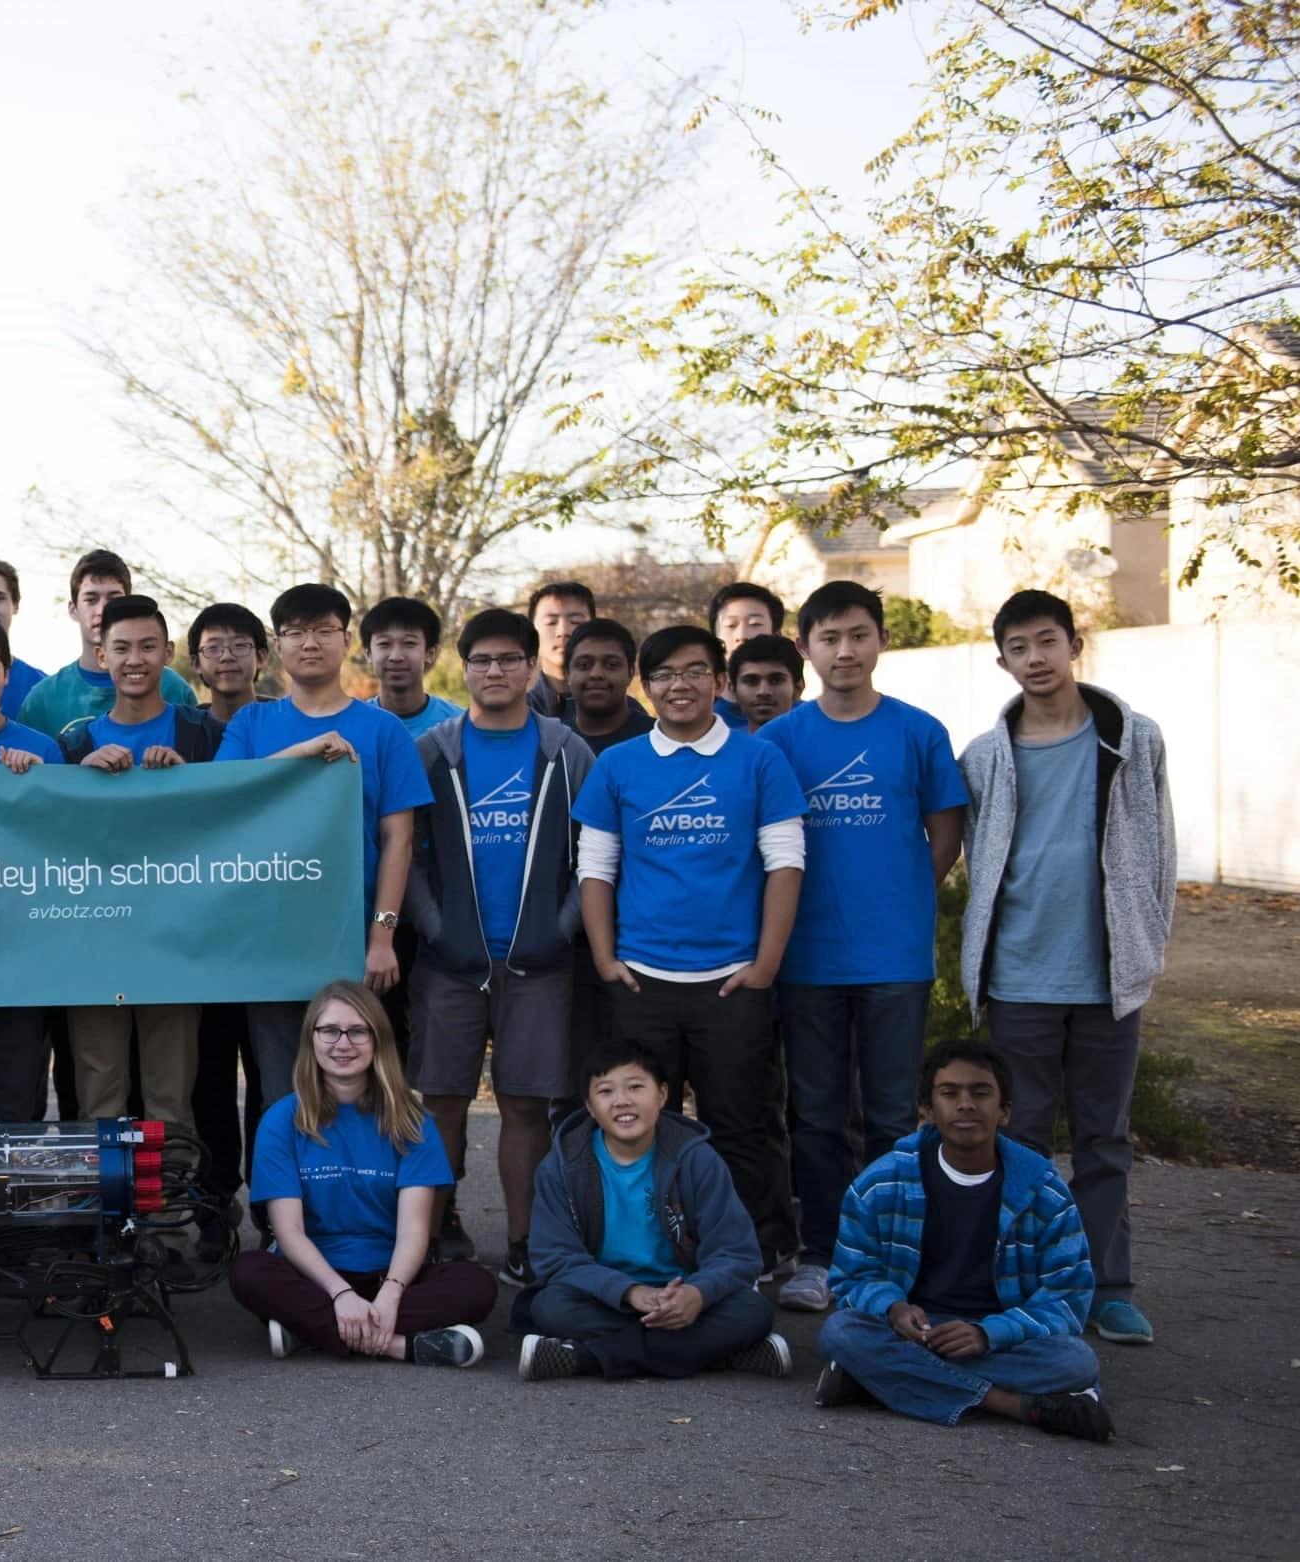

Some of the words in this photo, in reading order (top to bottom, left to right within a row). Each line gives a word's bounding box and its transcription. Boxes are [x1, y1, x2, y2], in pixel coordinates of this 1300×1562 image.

[809, 793, 883, 811] AVBotz
[470, 810, 529, 828] AVBot
[649, 813, 725, 832] AVBotz
[852, 813, 887, 826] 2017
[472, 832, 501, 845] arlin
[645, 834, 685, 847] Marlin
[697, 832, 730, 845] 2017
[44, 857, 102, 895] high
[110, 854, 203, 886] school
[210, 852, 323, 884] robotics
[28, 904, 132, 920] avbotz.com
